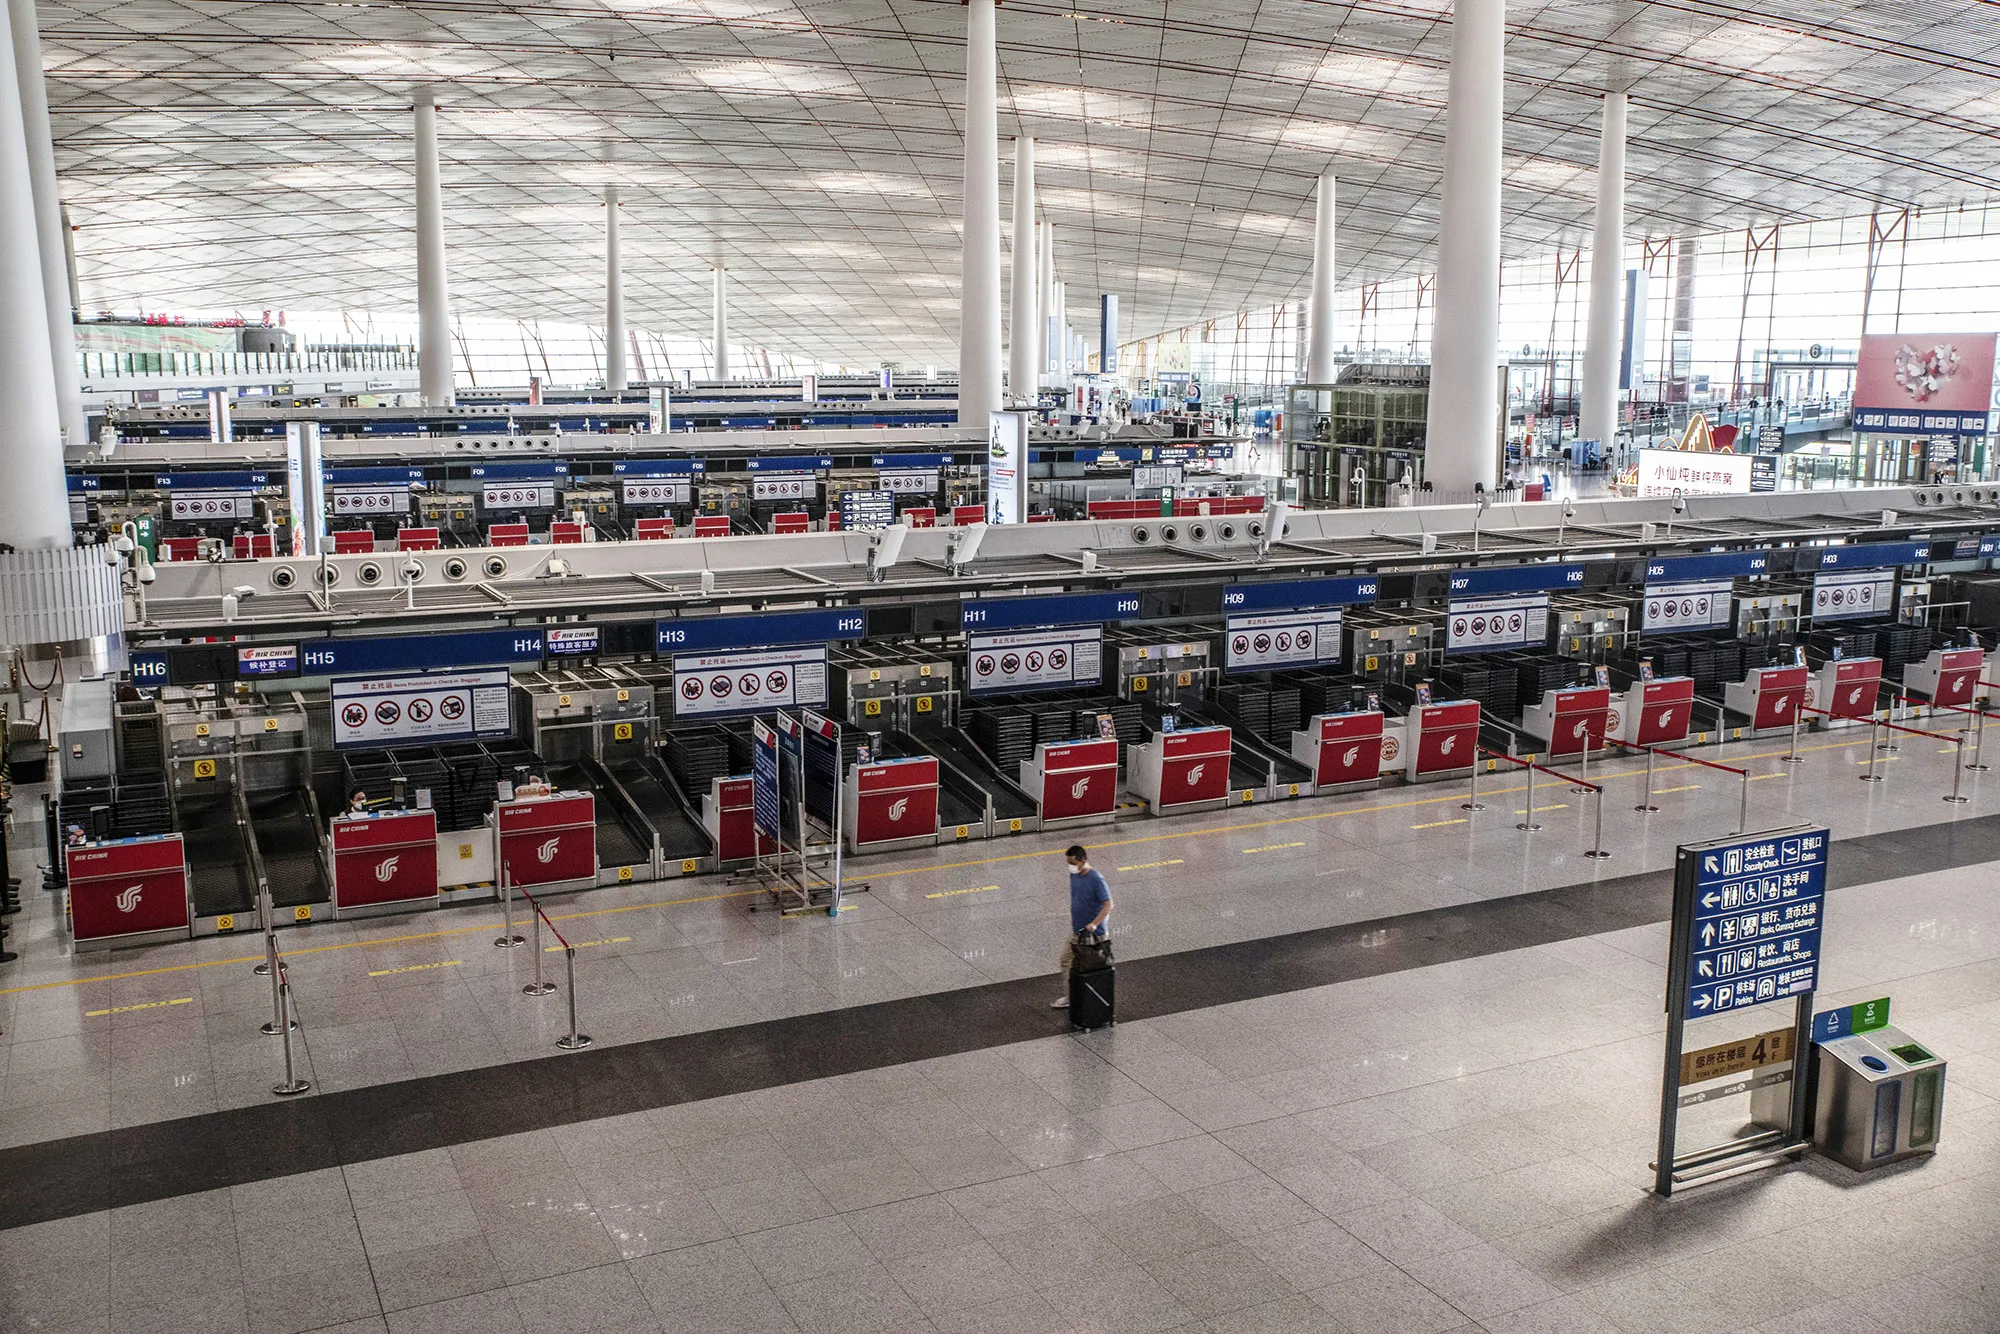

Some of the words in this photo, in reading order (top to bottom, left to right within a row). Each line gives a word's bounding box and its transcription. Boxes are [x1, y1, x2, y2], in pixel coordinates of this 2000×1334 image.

[1810, 344, 1821, 358] 6
[1050, 359, 1058, 371] D
[1066, 360, 1073, 369] C
[1107, 356, 1116, 371] E
[1633, 364, 1641, 387] F
[1224, 448, 1231, 457] F
[82, 479, 97, 487] F14
[157, 477, 171, 485] F13
[252, 475, 266, 483] F12
[1914, 548, 1929, 558] H02
[1981, 543, 1994, 553] H01
[1750, 559, 1766, 569] H04
[1822, 553, 1838, 564] H03
[1566, 571, 1583, 581] H06
[1648, 565, 1664, 576] H05
[1451, 578, 1469, 589] H07
[1358, 584, 1376, 595] H08
[1224, 593, 1244, 604] H09
[1117, 600, 1138, 611] H10
[964, 609, 986, 622] H11
[838, 618, 863, 630] H12
[659, 630, 685, 643] H13
[514, 640, 542, 652] H14
[305, 651, 335, 665] H15
[700, 657, 726, 665] 禁止托运
[133, 662, 166, 677] H16
[249, 660, 287, 669] 候补登记
[362, 682, 393, 690] 禁止托运
[1745, 844, 1775, 860] 安全检查
[1802, 837, 1822, 851] 登机口
[1744, 861, 1764, 873] Security
[1763, 859, 1779, 869] Check
[1802, 852, 1817, 862] Gates
[1782, 870, 1810, 887] 洗手间
[1782, 888, 1798, 898] Toilet
[1757, 954, 1793, 969] Restaurants,
[1792, 950, 1812, 962] Shops
[1736, 980, 1756, 995] 停车场
[1778, 973, 1791, 985] 地铁
[1734, 996, 1754, 1007] Parking
[1695, 1046, 1746, 1069] 您所在楼层
[1752, 1038, 1767, 1065] 4
[1771, 1036, 1780, 1049] 层
[1771, 1050, 1778, 1061] F
